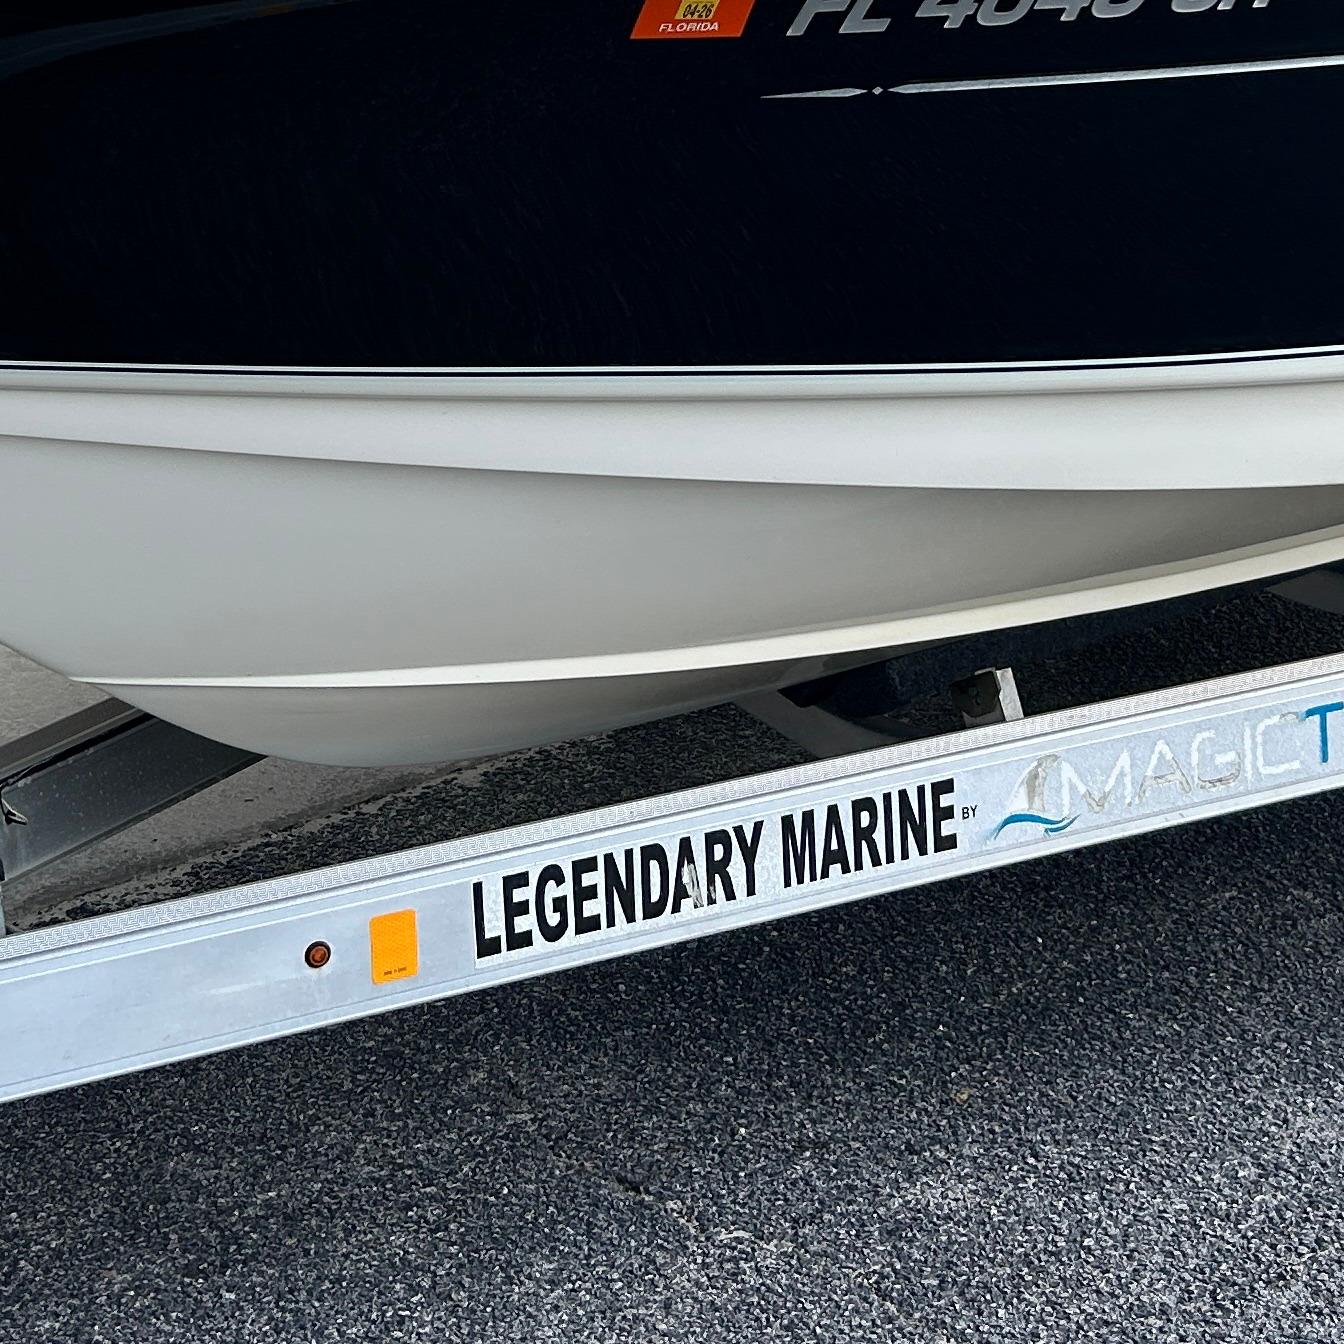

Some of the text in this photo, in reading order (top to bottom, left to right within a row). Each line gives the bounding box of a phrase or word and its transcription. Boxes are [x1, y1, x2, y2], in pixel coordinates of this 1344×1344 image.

[682, 3, 714, 19] 04-26
[658, 22, 720, 33] FLORIDA
[472, 778, 978, 959] LEGENDARY MARINE BY
